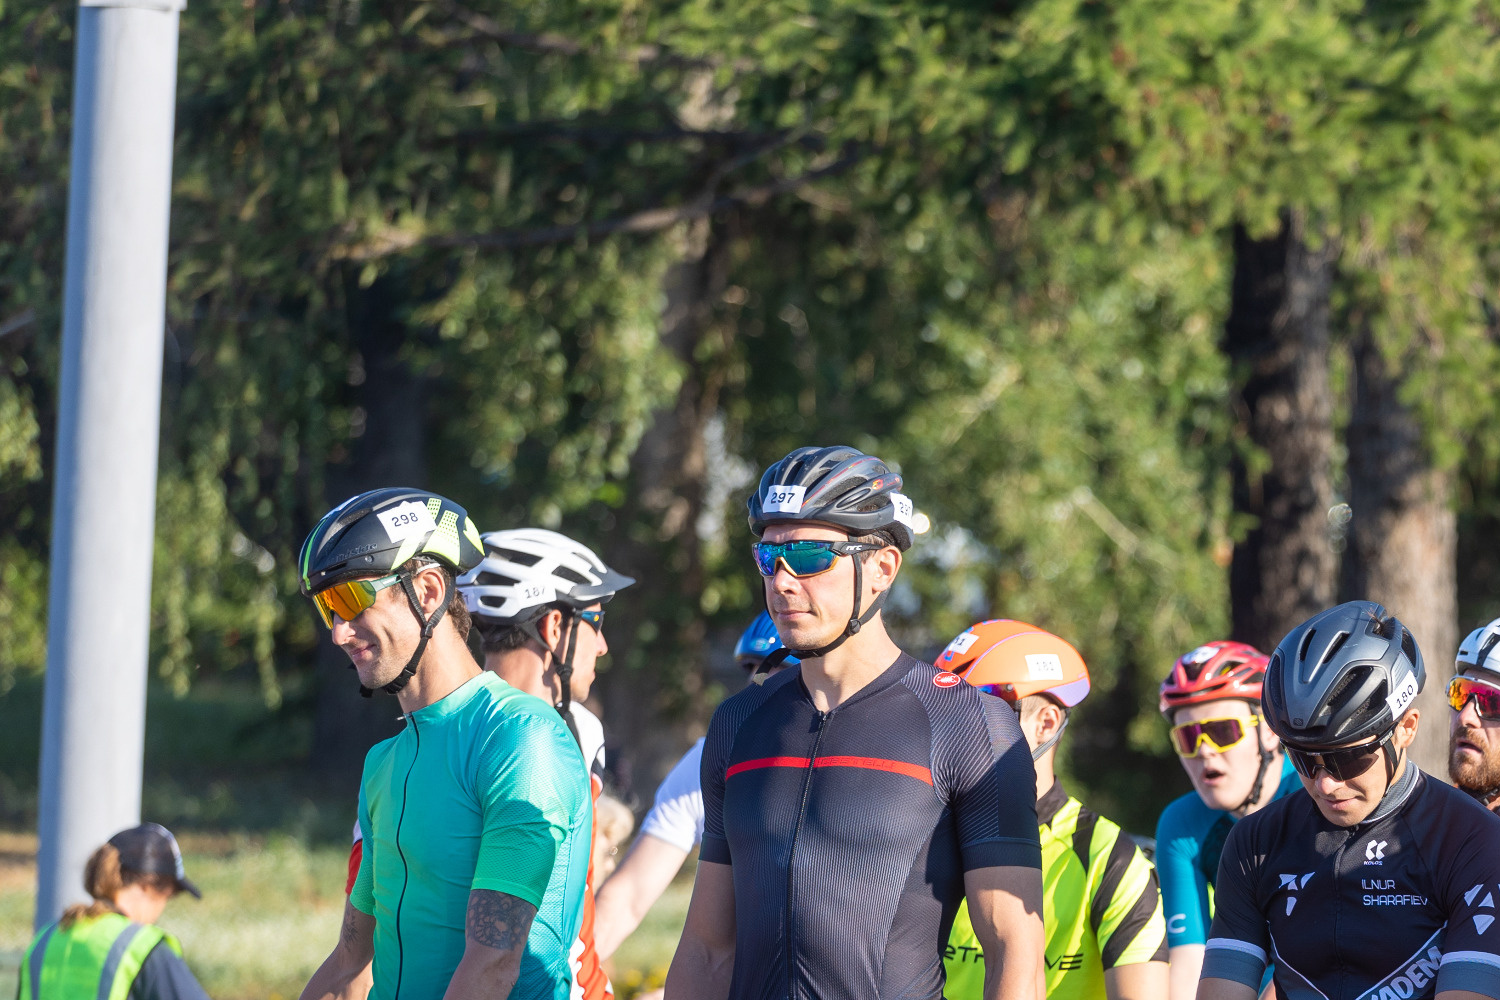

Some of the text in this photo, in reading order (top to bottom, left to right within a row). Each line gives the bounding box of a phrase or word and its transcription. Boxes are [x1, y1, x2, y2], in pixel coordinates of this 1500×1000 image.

[770, 492, 795, 504] 297
[391, 512, 418, 527] 298
[1397, 683, 1414, 709] 180
[1361, 878, 1396, 890] ILNUR
[1362, 893, 1429, 907] SHARAFIEV
